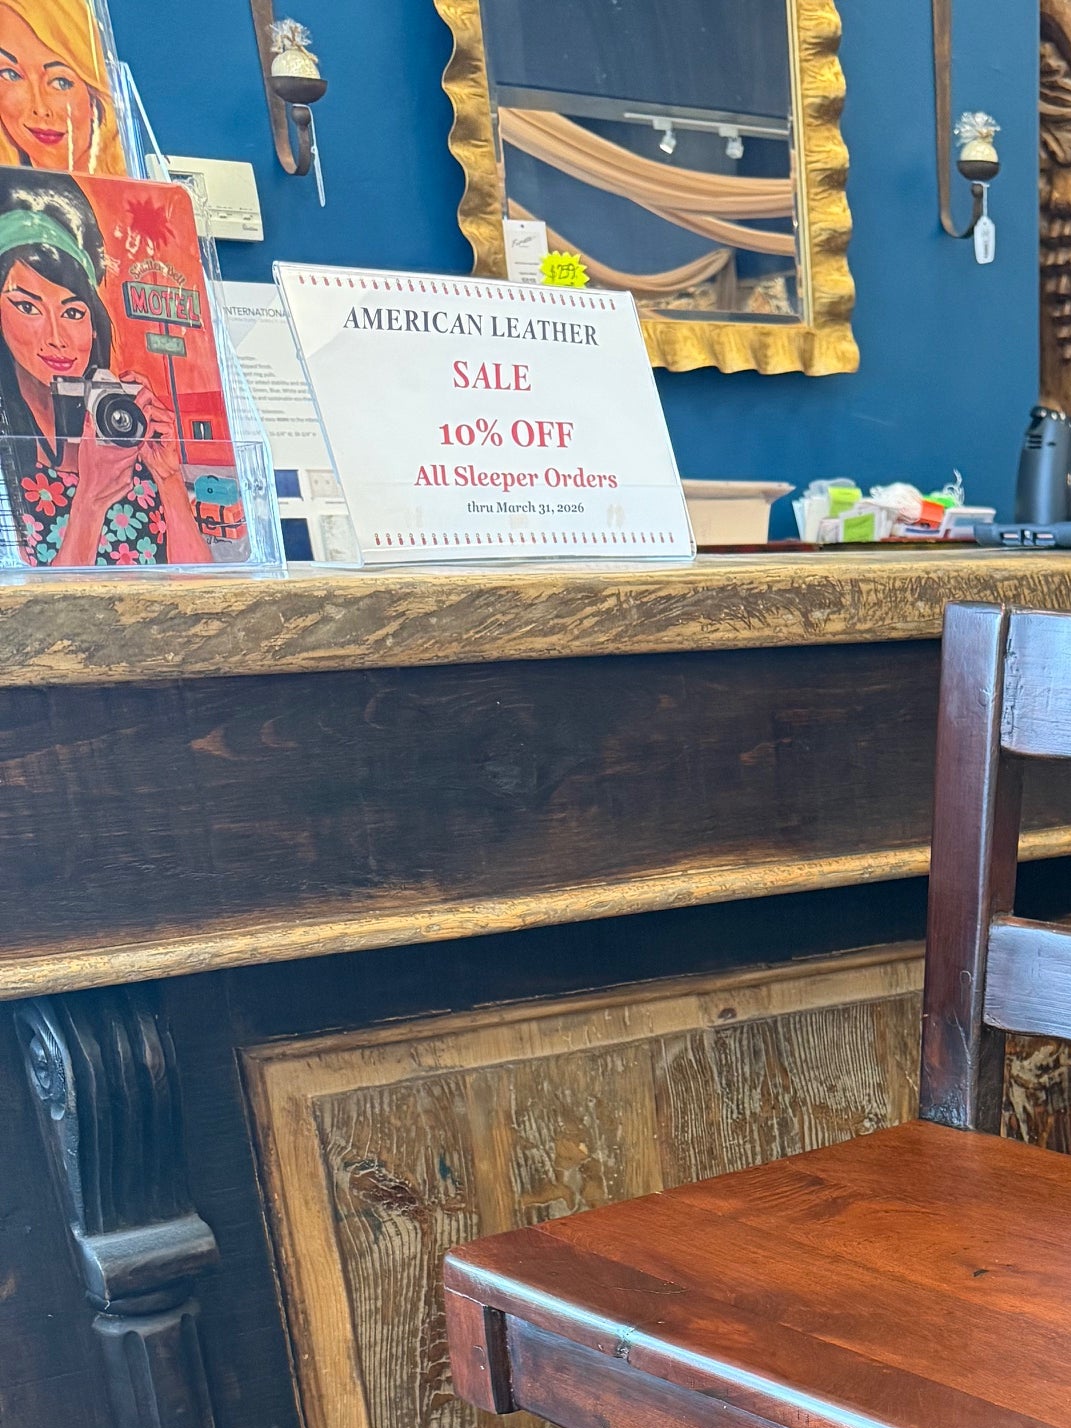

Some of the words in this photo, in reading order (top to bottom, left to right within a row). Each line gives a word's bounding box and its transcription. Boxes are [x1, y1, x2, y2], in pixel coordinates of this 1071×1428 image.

[130, 285, 199, 321] MOTEL
[343, 306, 483, 336] AMERICAN
[490, 315, 600, 346] LEATHER
[453, 360, 532, 392] SALE
[438, 418, 504, 447] 10%
[510, 419, 575, 448] OFF
[414, 464, 451, 487] All
[454, 465, 539, 492] Sleeper
[544, 467, 618, 489] Orders
[467, 500, 494, 514] thru
[496, 501, 536, 514] March
[538, 504, 555, 516] 31,
[557, 502, 585, 514] 2026
